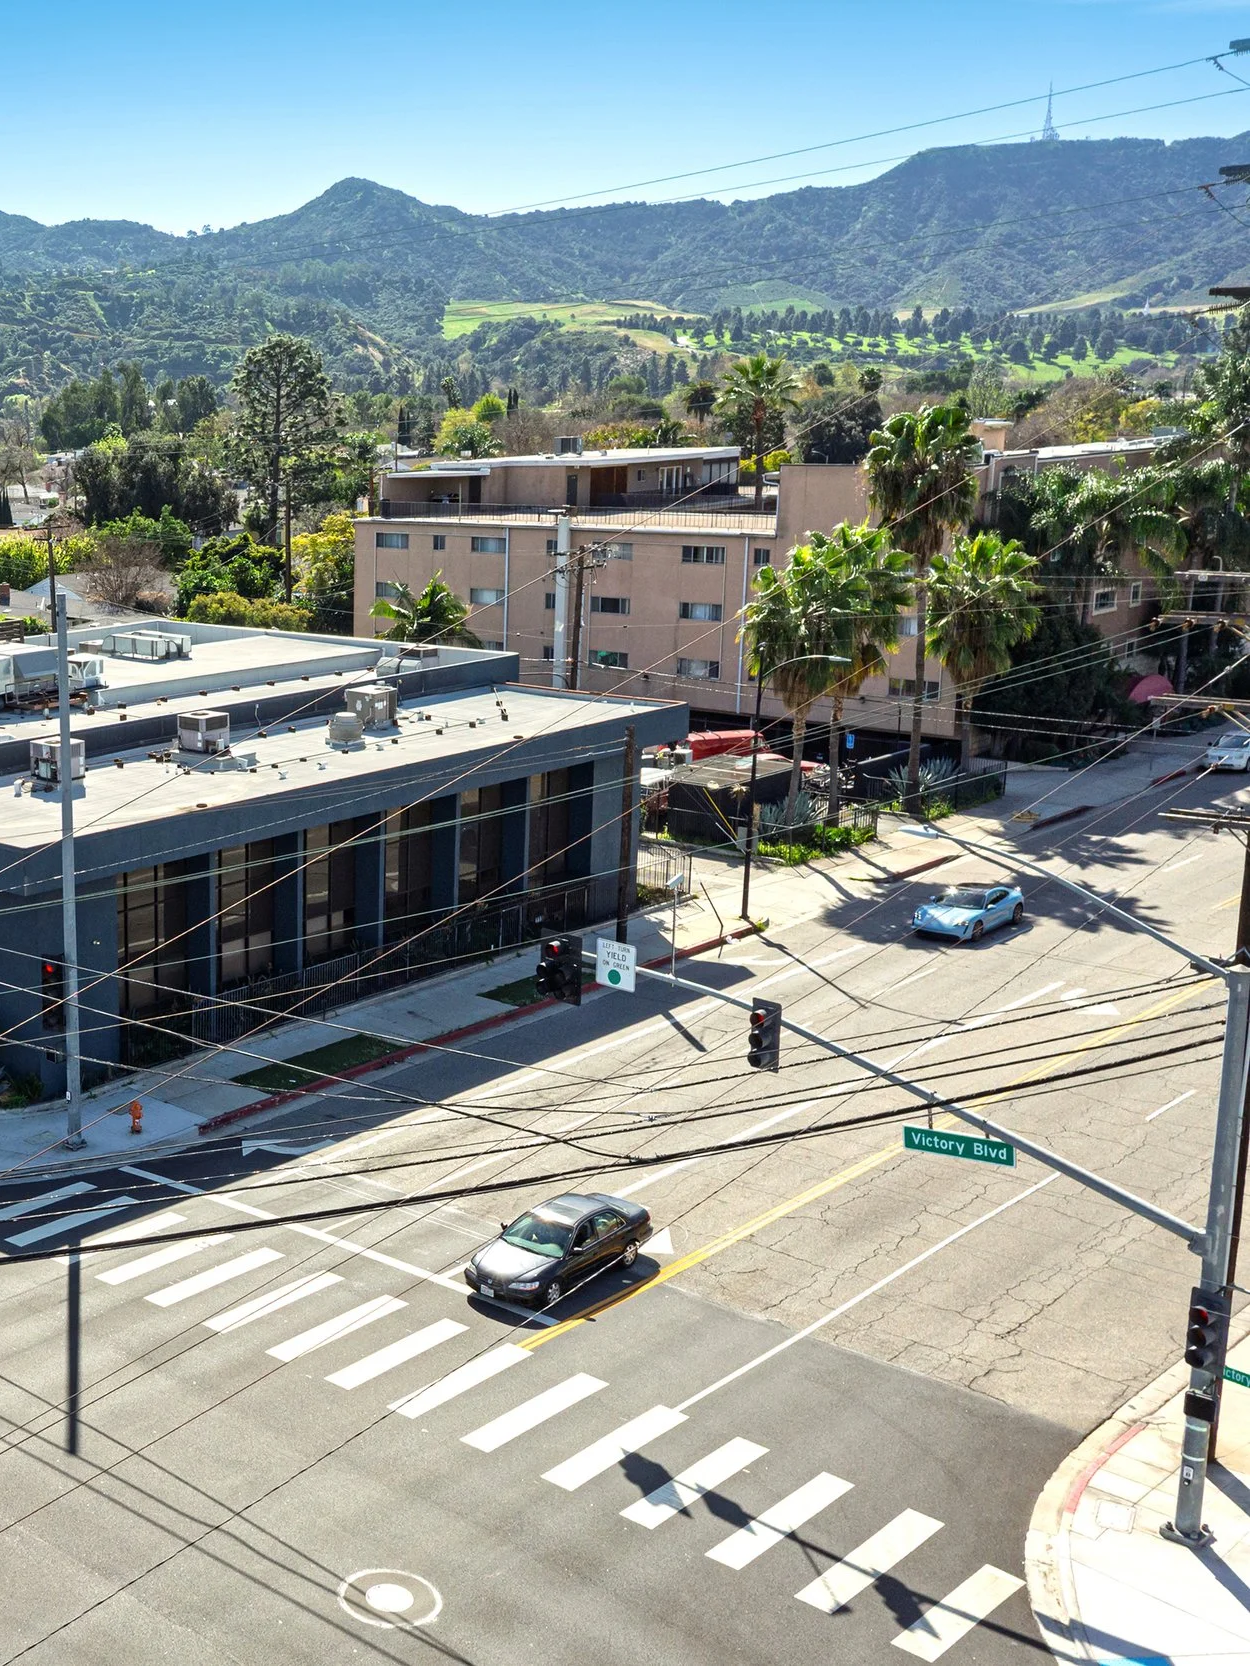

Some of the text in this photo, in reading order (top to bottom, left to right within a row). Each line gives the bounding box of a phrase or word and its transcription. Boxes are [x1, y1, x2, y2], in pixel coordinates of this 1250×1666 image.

[602, 941, 631, 954] LEFT TURN
[606, 950, 627, 962] YIELD
[613, 961, 630, 971] GREEN
[911, 1131, 1007, 1160] Victory Blvd
[1223, 1366, 1250, 1388] ictory
